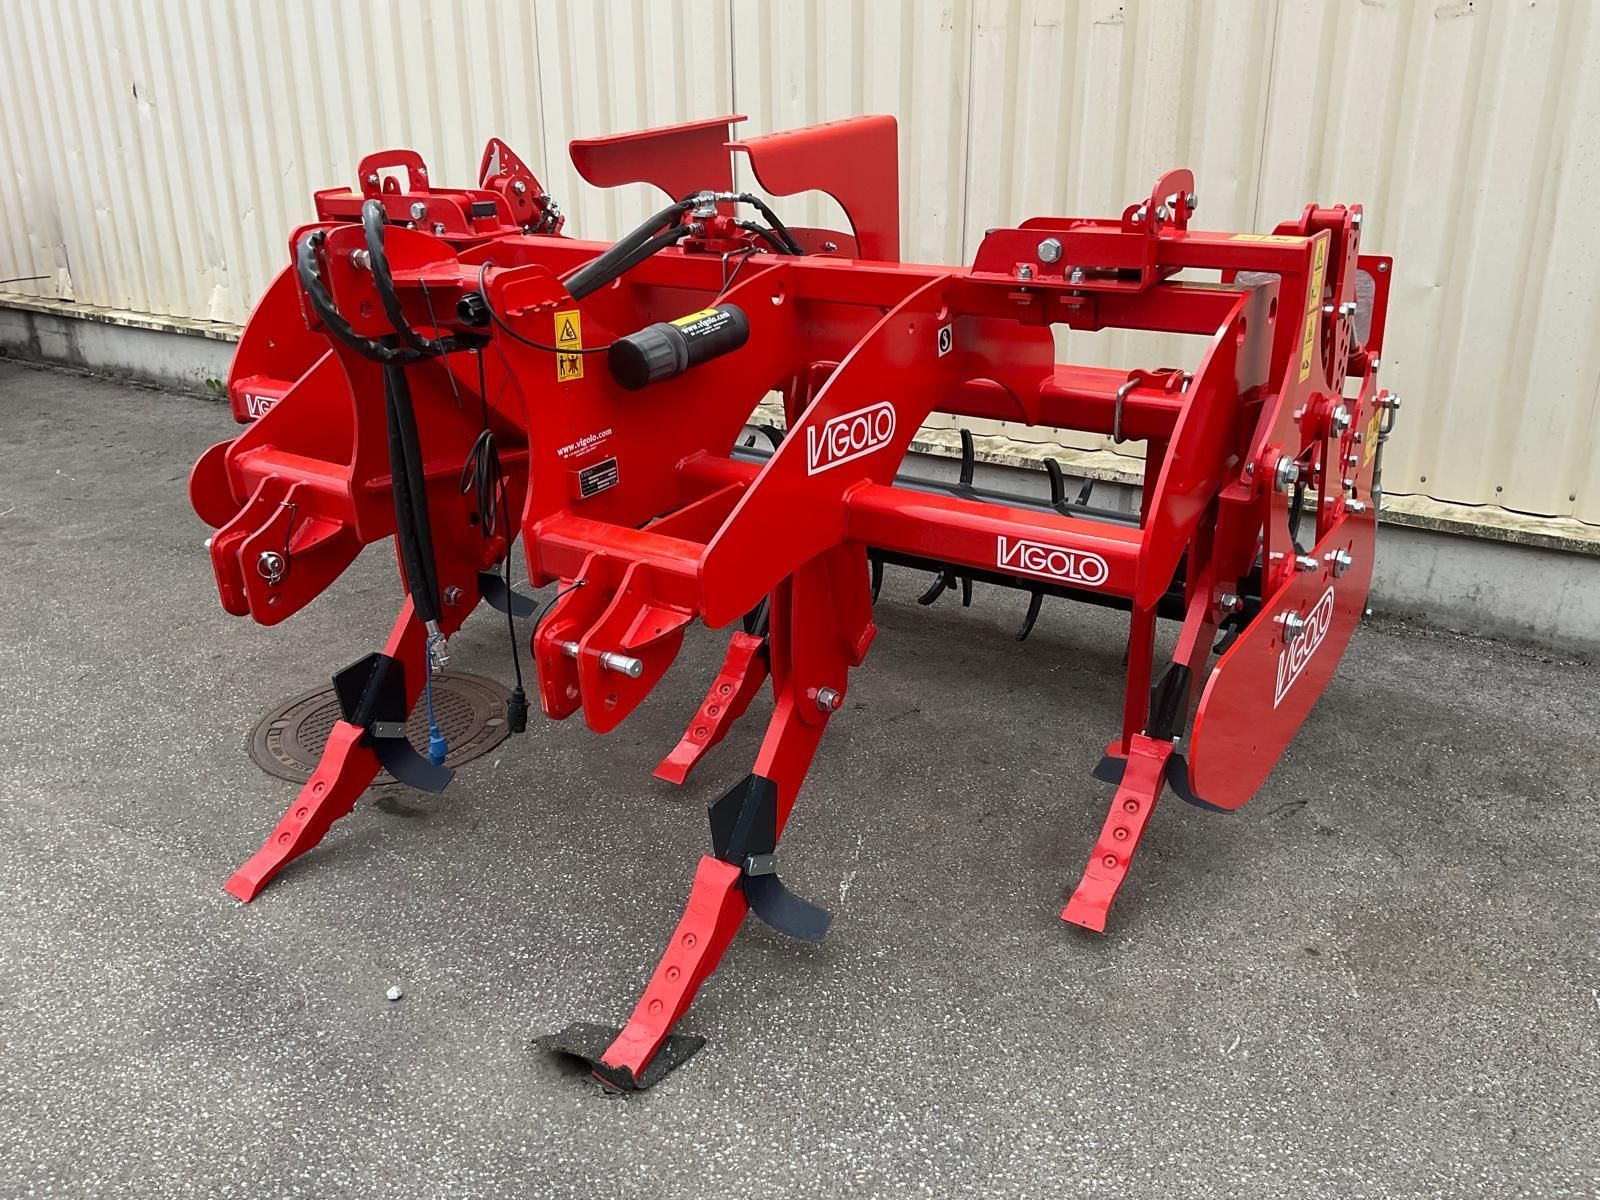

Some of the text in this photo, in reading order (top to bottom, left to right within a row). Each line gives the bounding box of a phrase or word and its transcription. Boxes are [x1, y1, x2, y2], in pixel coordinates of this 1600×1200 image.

[557, 428, 612, 456] www.vigolo.com
[807, 402, 896, 475] VIGOLO
[997, 536, 1108, 586] VIGOLO
[1274, 587, 1334, 709] VIGOLO
